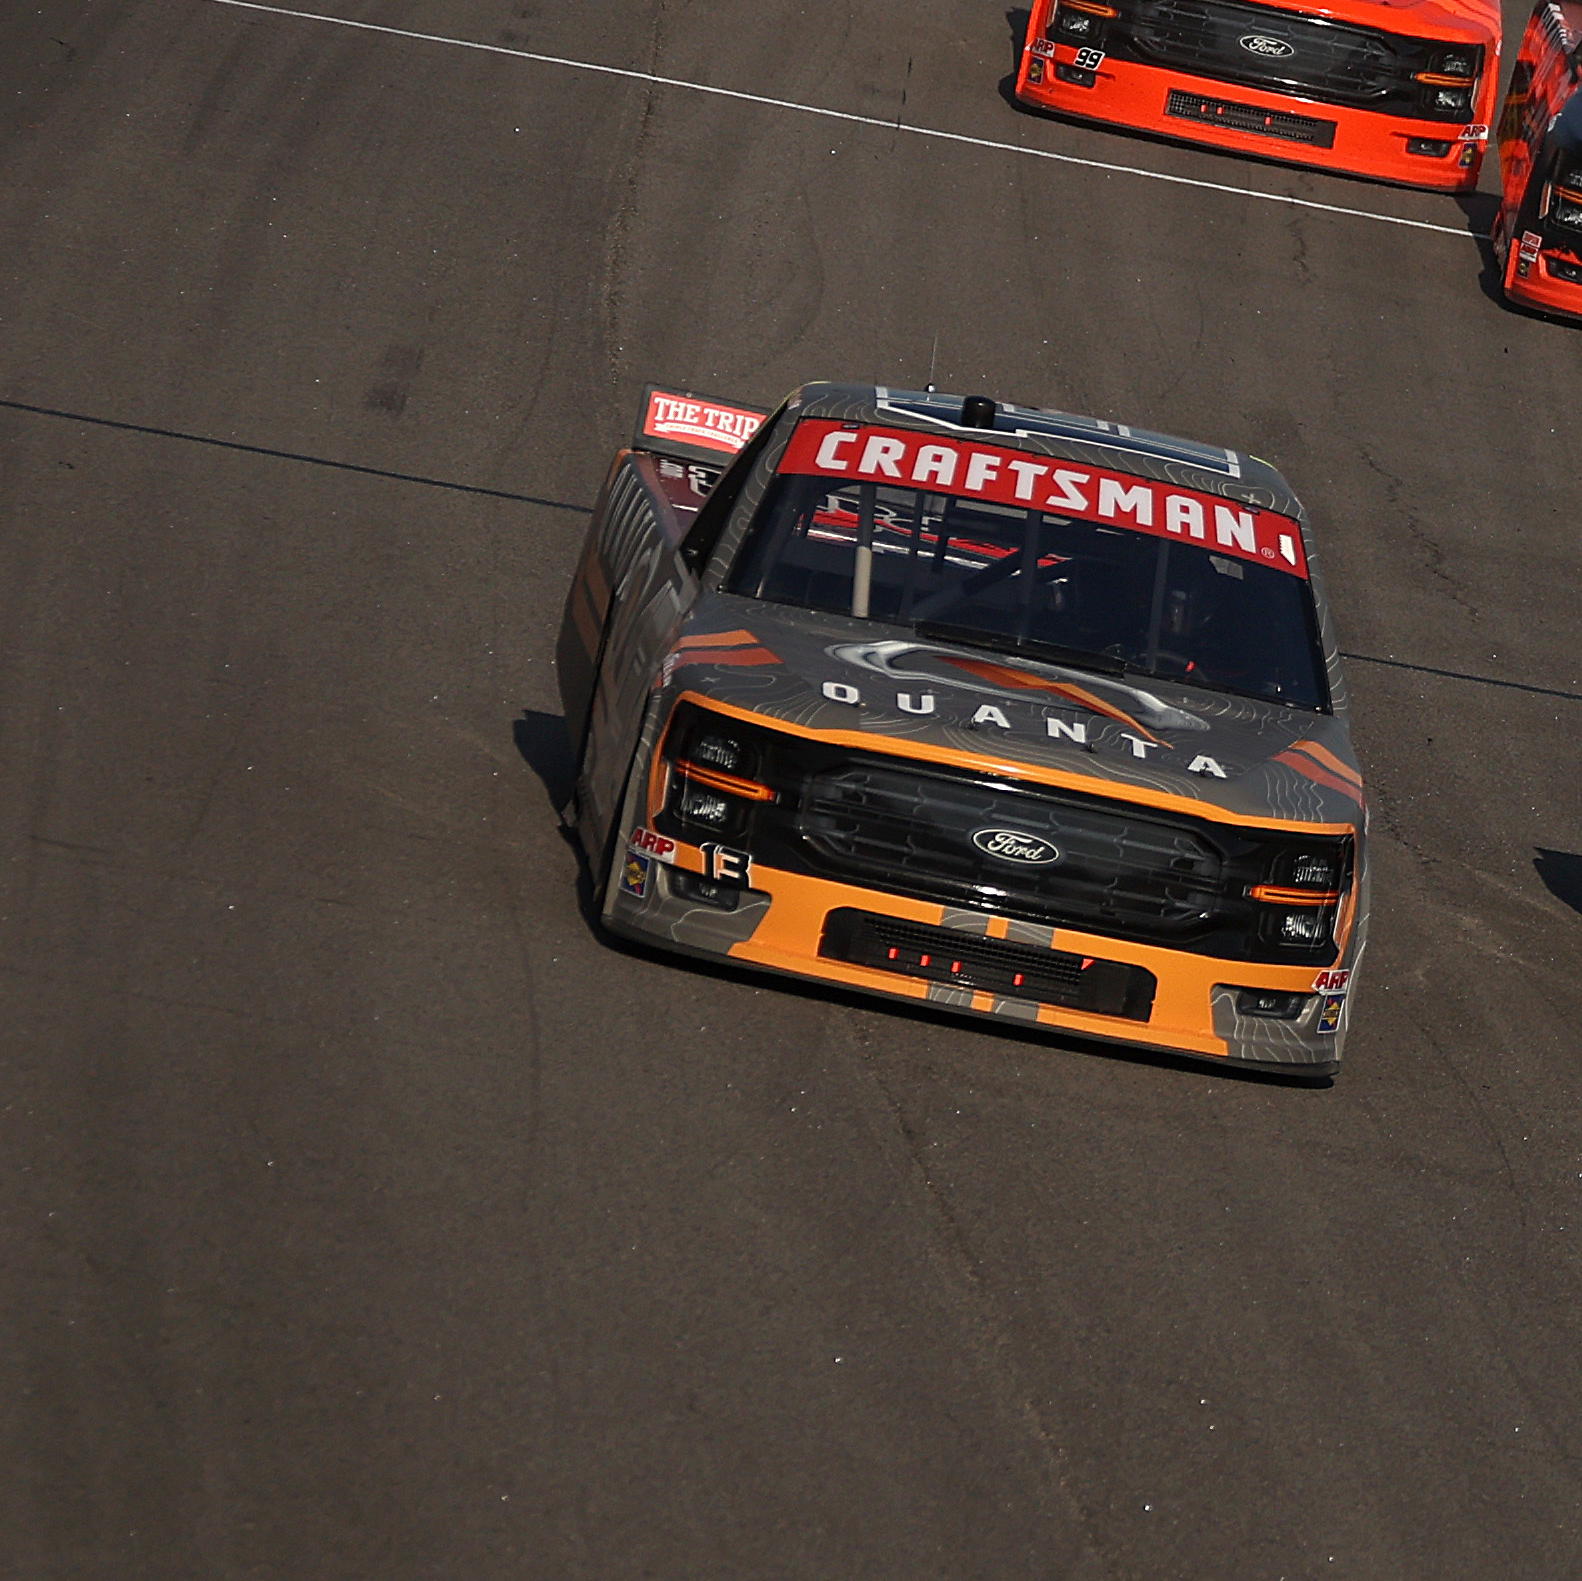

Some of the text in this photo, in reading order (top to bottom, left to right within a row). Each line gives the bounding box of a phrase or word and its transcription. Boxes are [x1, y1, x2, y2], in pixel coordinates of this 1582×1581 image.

[1074, 47, 1103, 70] 99
[1248, 38, 1286, 55] Ford
[1461, 124, 1487, 138] ARP
[654, 396, 760, 442] THE TRIP
[814, 431, 1258, 554] CRAFTSMAN
[631, 828, 675, 856] ARP
[987, 832, 1045, 861] Ford
[700, 842, 752, 890] 13
[1315, 970, 1350, 990] ARP
